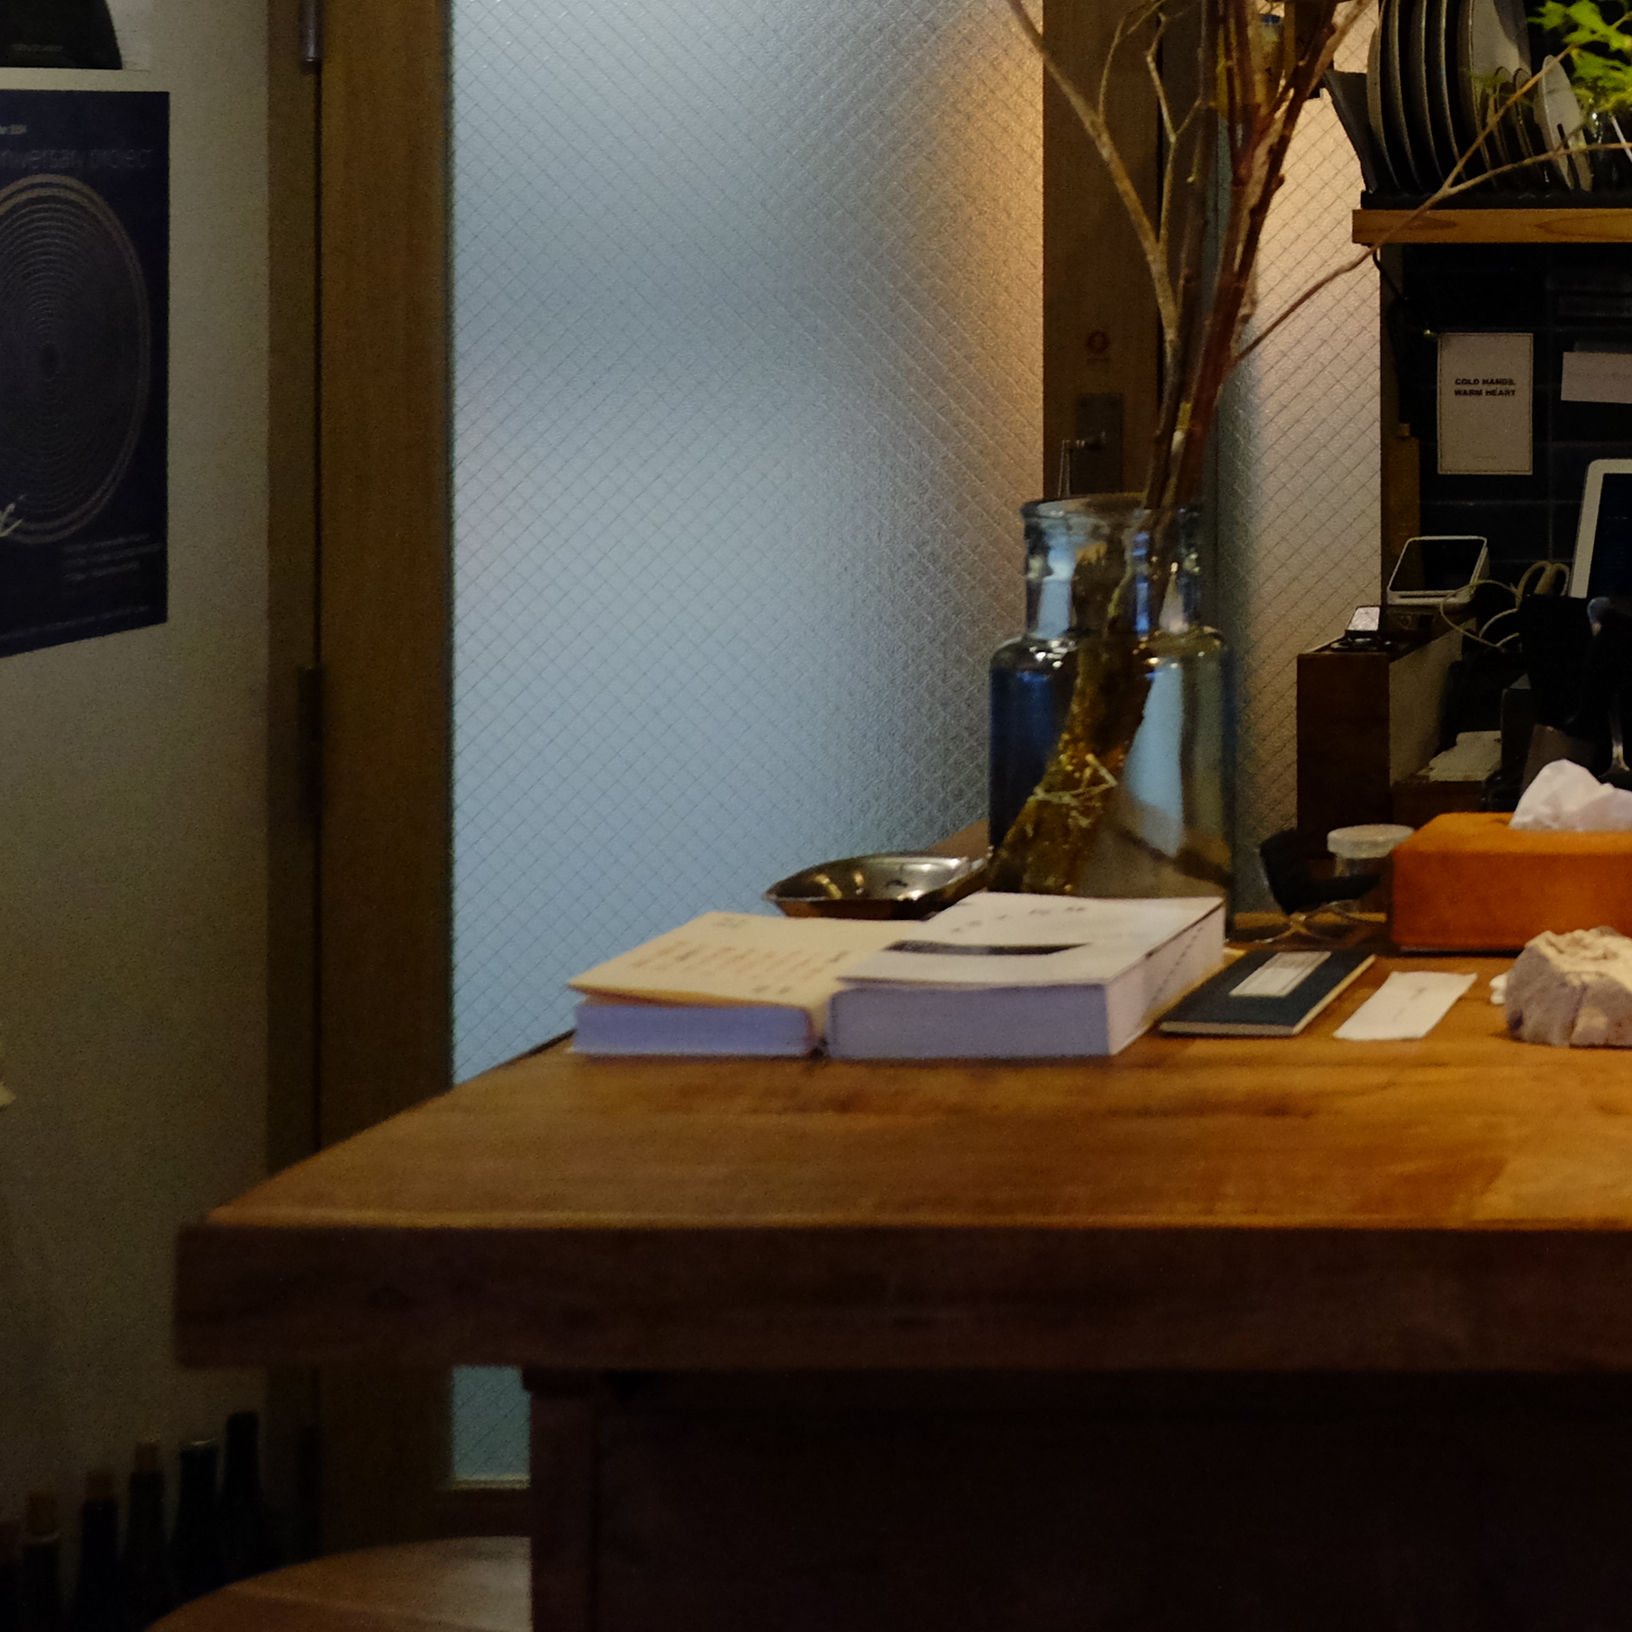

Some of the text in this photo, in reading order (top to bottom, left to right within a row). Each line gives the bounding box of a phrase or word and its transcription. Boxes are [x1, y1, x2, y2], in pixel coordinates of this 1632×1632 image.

[1454, 378, 1480, 386] COLD
[1454, 389, 1516, 397] WARM HEART
